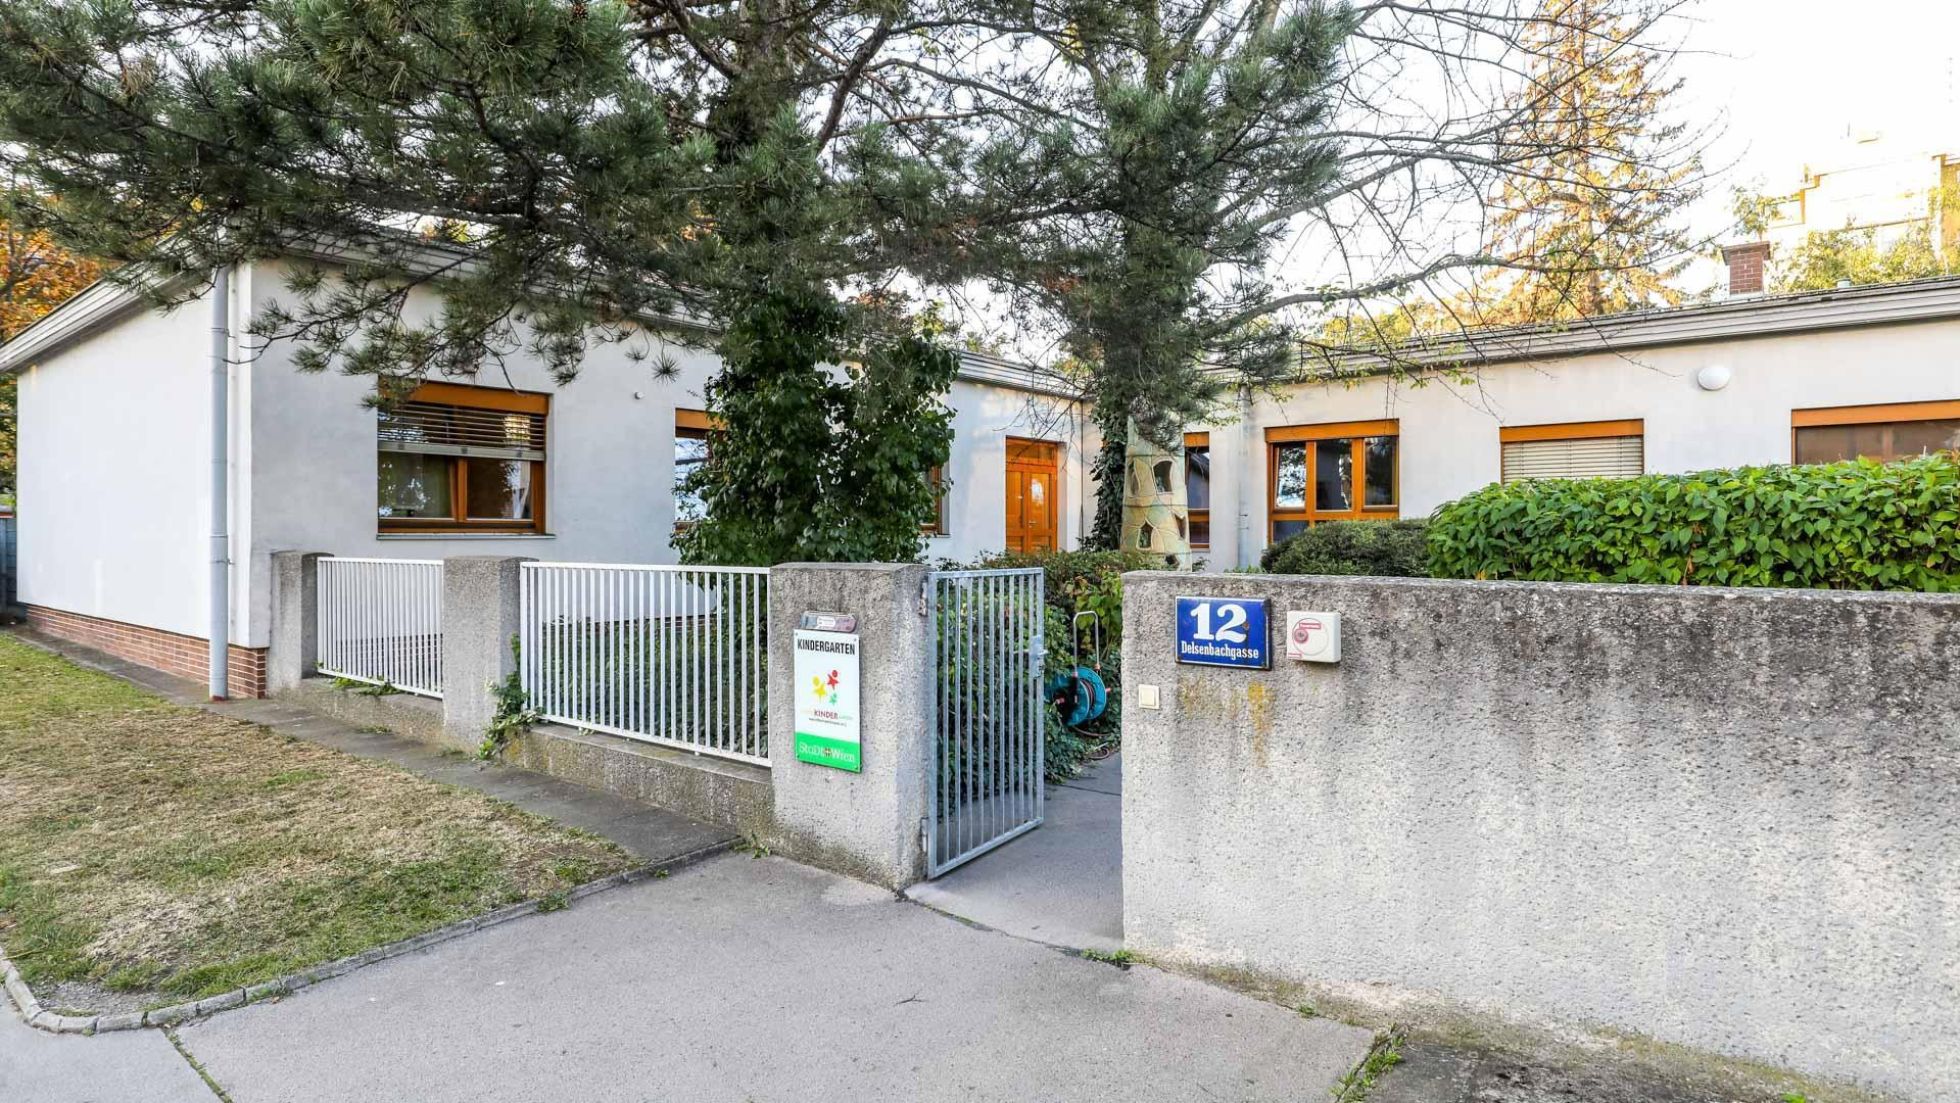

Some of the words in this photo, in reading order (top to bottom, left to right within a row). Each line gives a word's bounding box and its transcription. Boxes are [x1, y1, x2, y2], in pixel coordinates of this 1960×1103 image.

[1190, 602, 1247, 644] 12
[797, 638, 856, 655] KINDERGARTEN
[1181, 640, 1260, 661] Delsenbachgasse
[814, 709, 839, 720] KINDER
